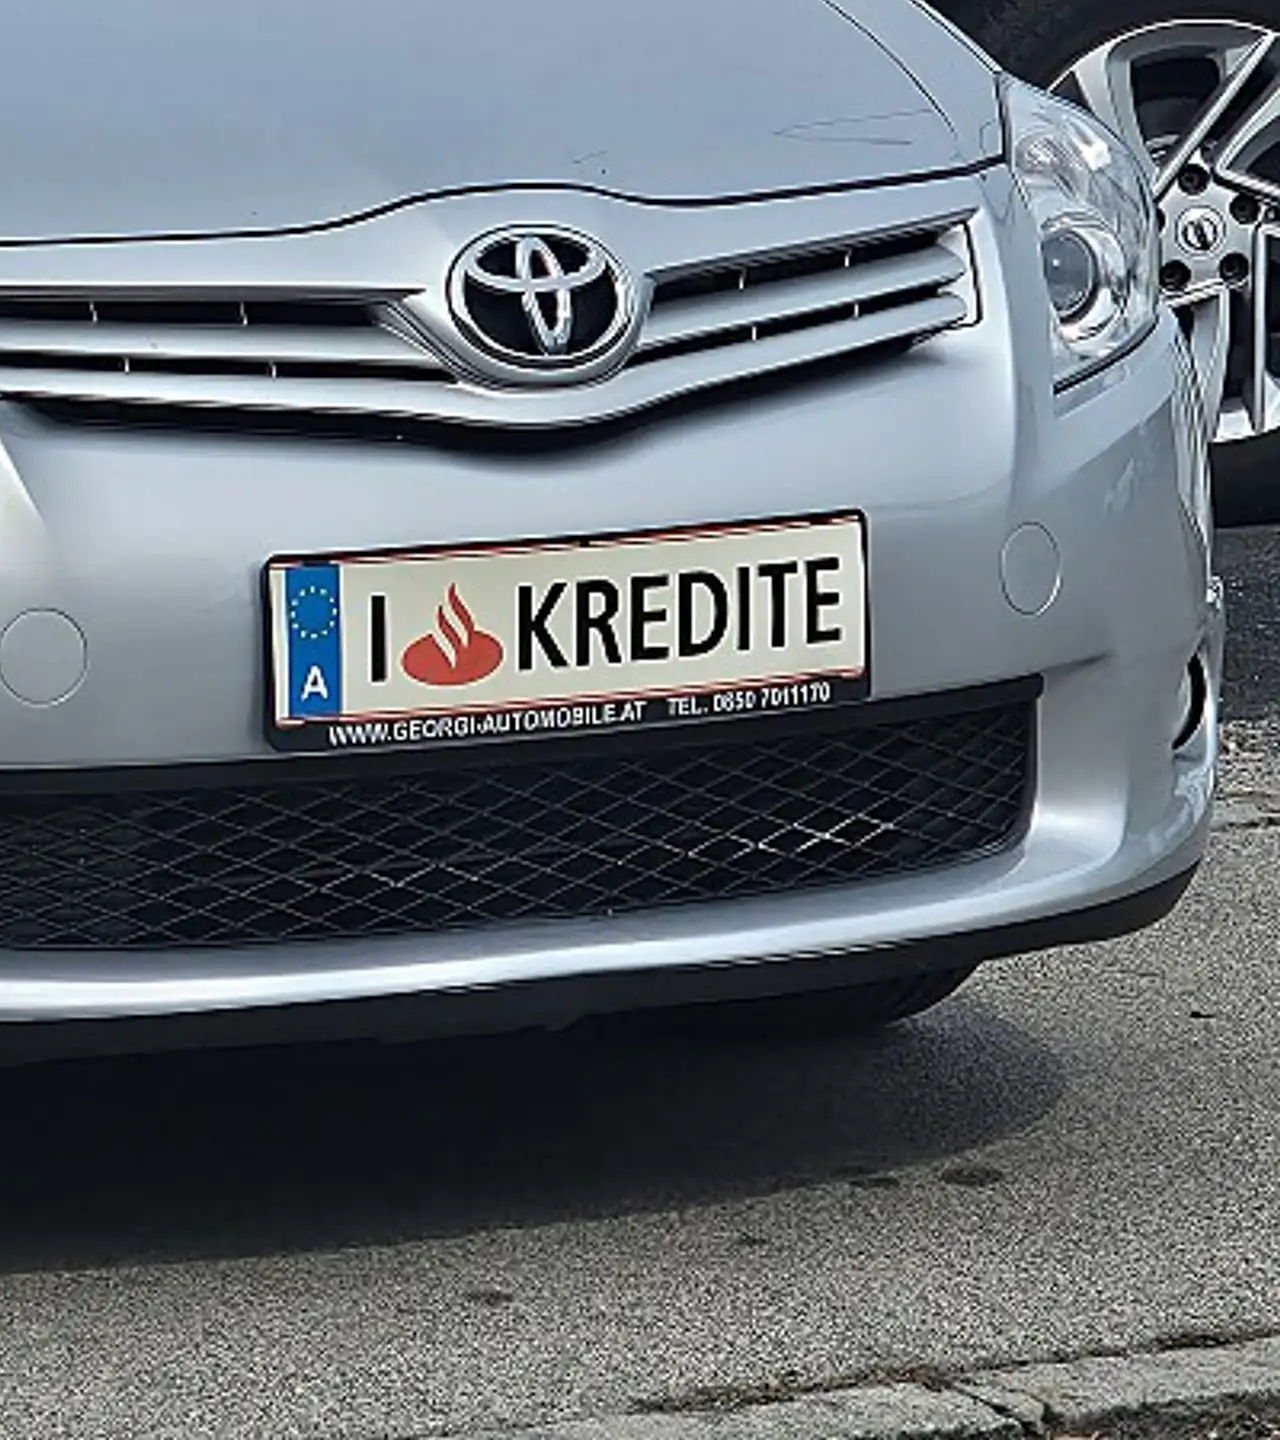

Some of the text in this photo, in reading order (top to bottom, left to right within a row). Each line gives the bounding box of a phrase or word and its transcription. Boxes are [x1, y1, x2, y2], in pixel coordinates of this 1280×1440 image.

[370, 556, 842, 682] I KREDITE
[301, 667, 327, 701] A
[329, 699, 646, 747] WWW.GEORGI-AUTOMOBILE.AT
[667, 694, 708, 717] TEL.
